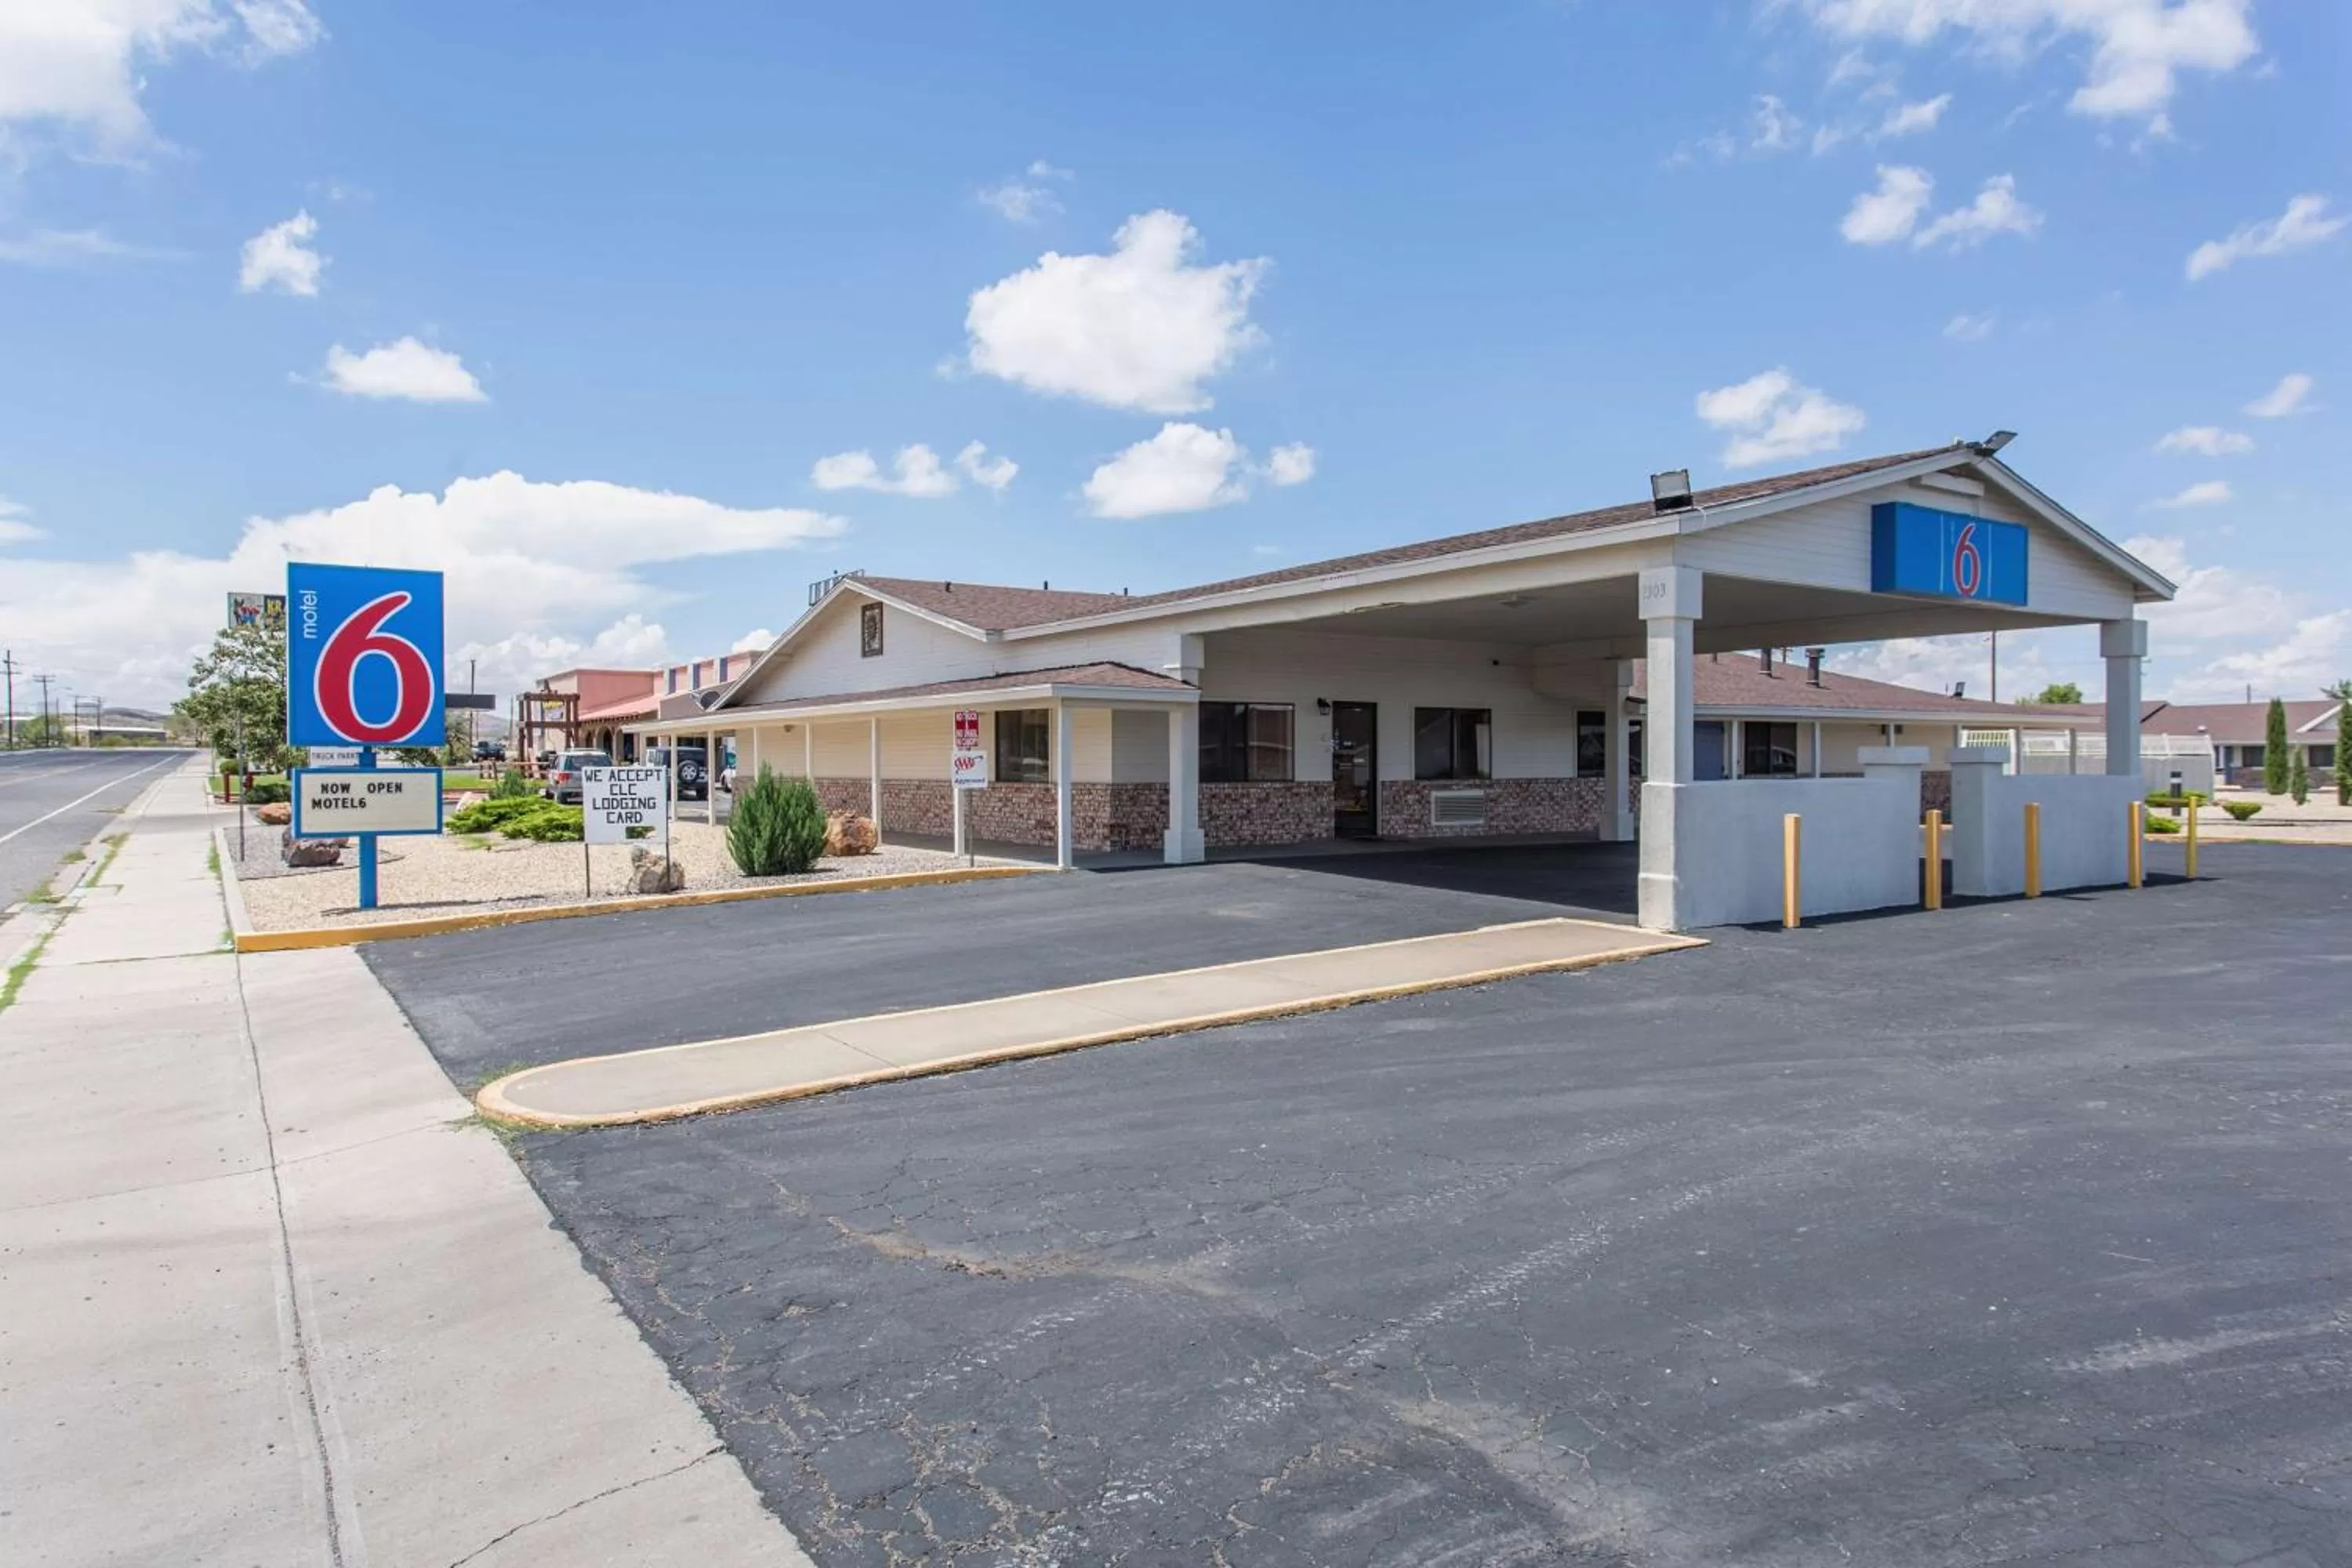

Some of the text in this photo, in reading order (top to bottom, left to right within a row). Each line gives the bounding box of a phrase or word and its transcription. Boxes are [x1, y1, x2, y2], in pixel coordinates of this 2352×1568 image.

[1953, 523, 1980, 597] 6
[299, 590, 434, 742] motel 6
[584, 769, 662, 782] WE ACCEPT
[321, 782, 402, 794] NOW OPEN
[610, 784, 637, 796] CLC
[311, 798, 367, 809] MOTEL6
[593, 797, 656, 810] LODGING
[606, 811, 643, 824] CARD
